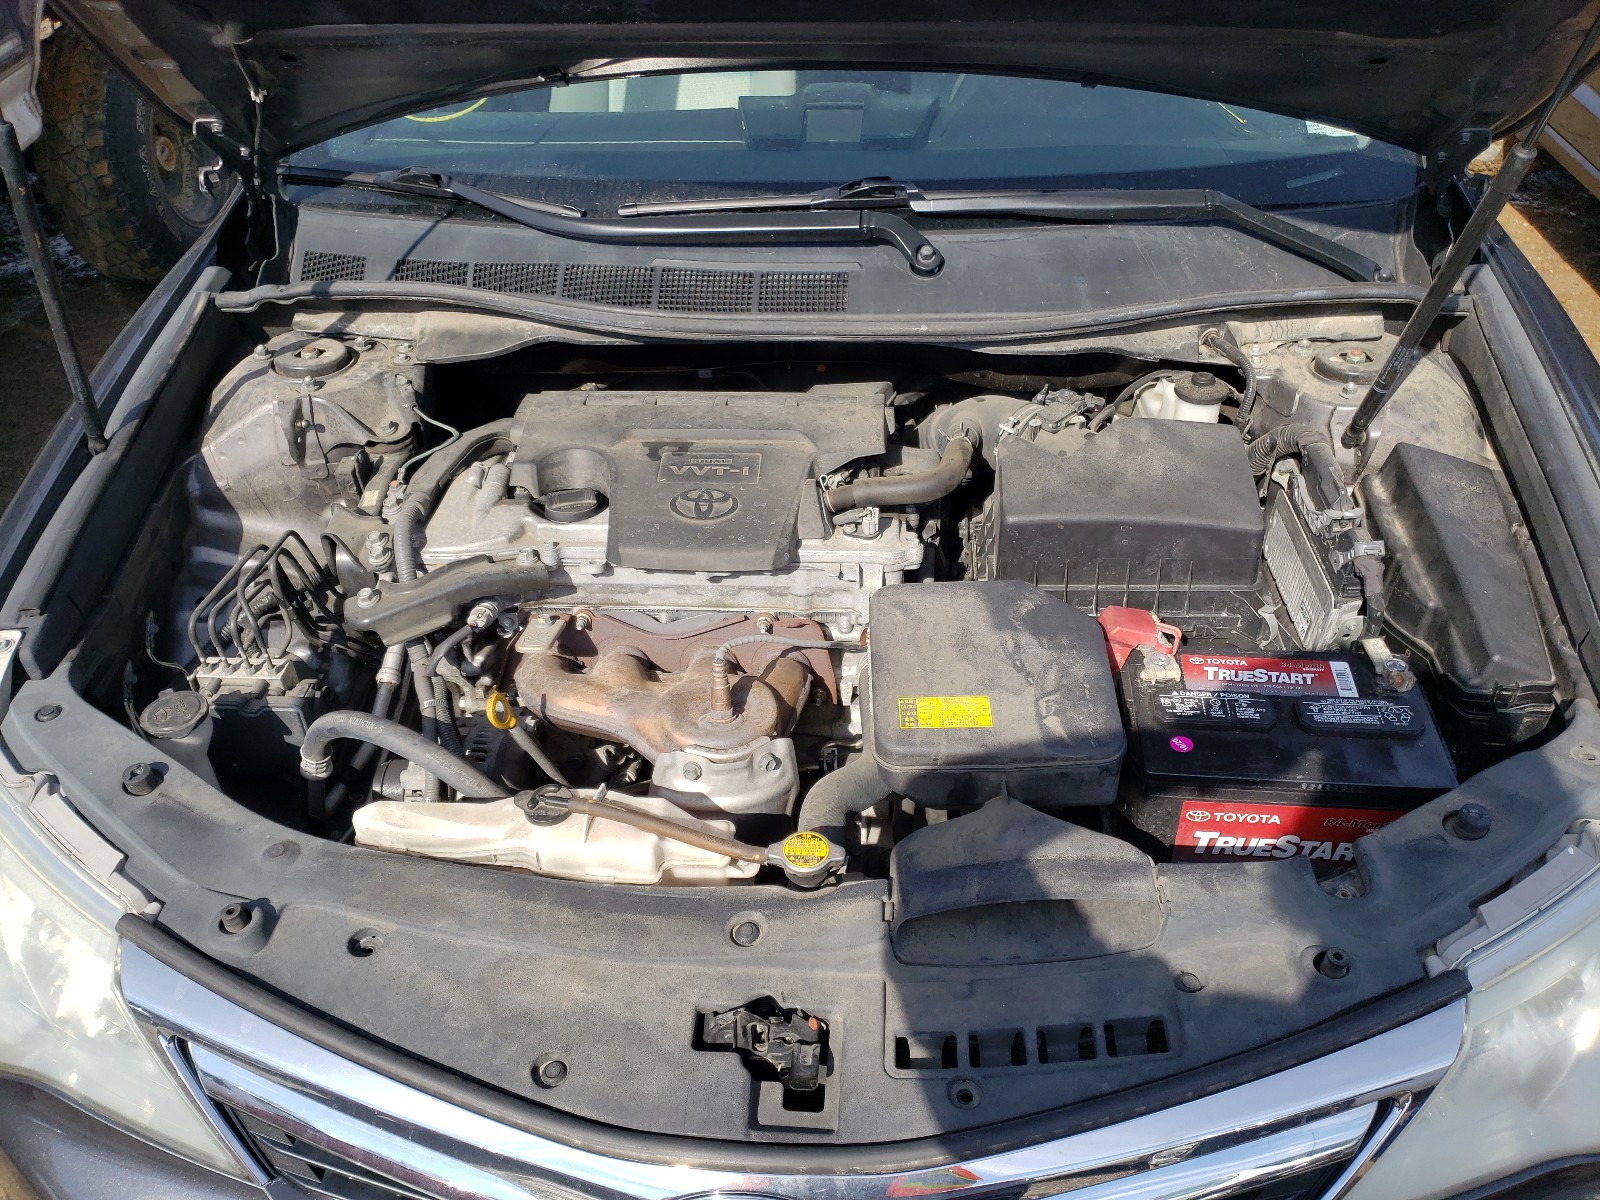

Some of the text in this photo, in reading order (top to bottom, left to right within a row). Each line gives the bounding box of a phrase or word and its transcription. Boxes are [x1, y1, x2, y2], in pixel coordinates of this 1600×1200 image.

[1205, 658, 1248, 667] TOYOTA
[1213, 812, 1281, 825] TOYOTA
[1323, 817, 1392, 830] 84-Mon
[1193, 830, 1354, 862] TRUESTAR
